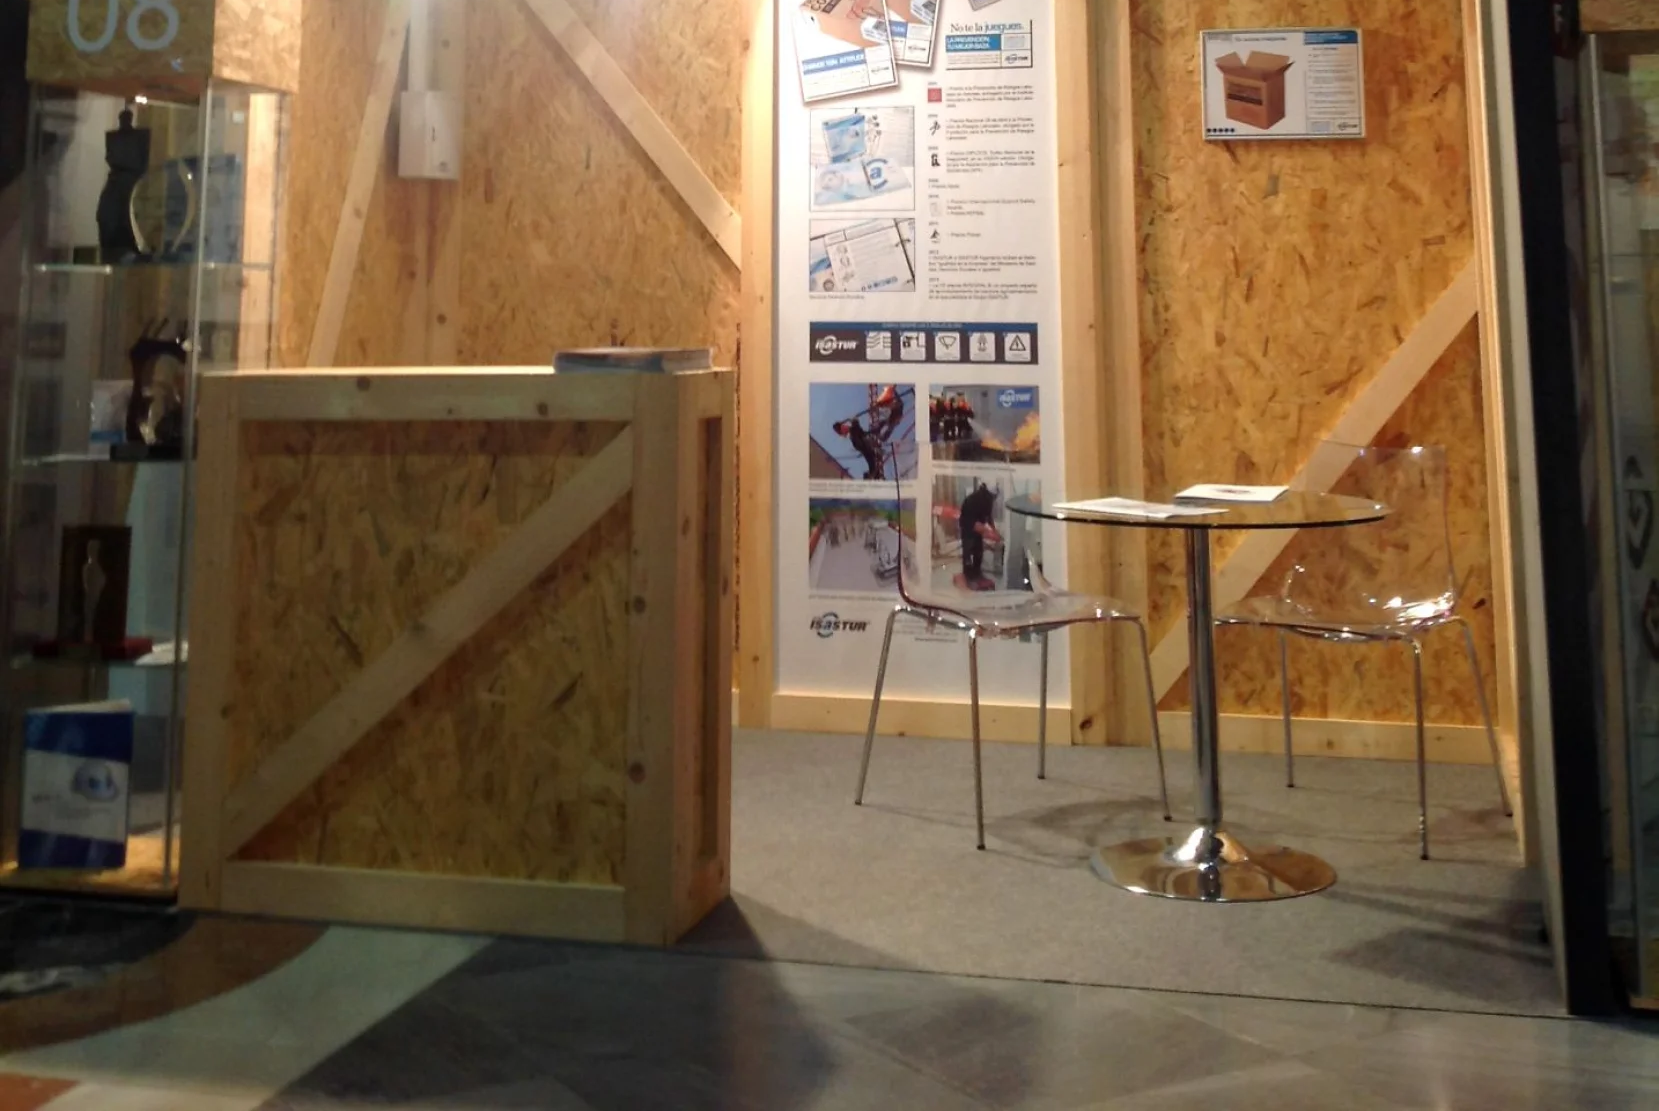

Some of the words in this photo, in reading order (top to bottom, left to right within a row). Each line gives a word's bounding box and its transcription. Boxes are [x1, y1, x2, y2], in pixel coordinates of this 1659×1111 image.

[951, 23, 964, 32] No
[965, 24, 974, 32] te
[975, 22, 983, 32] la
